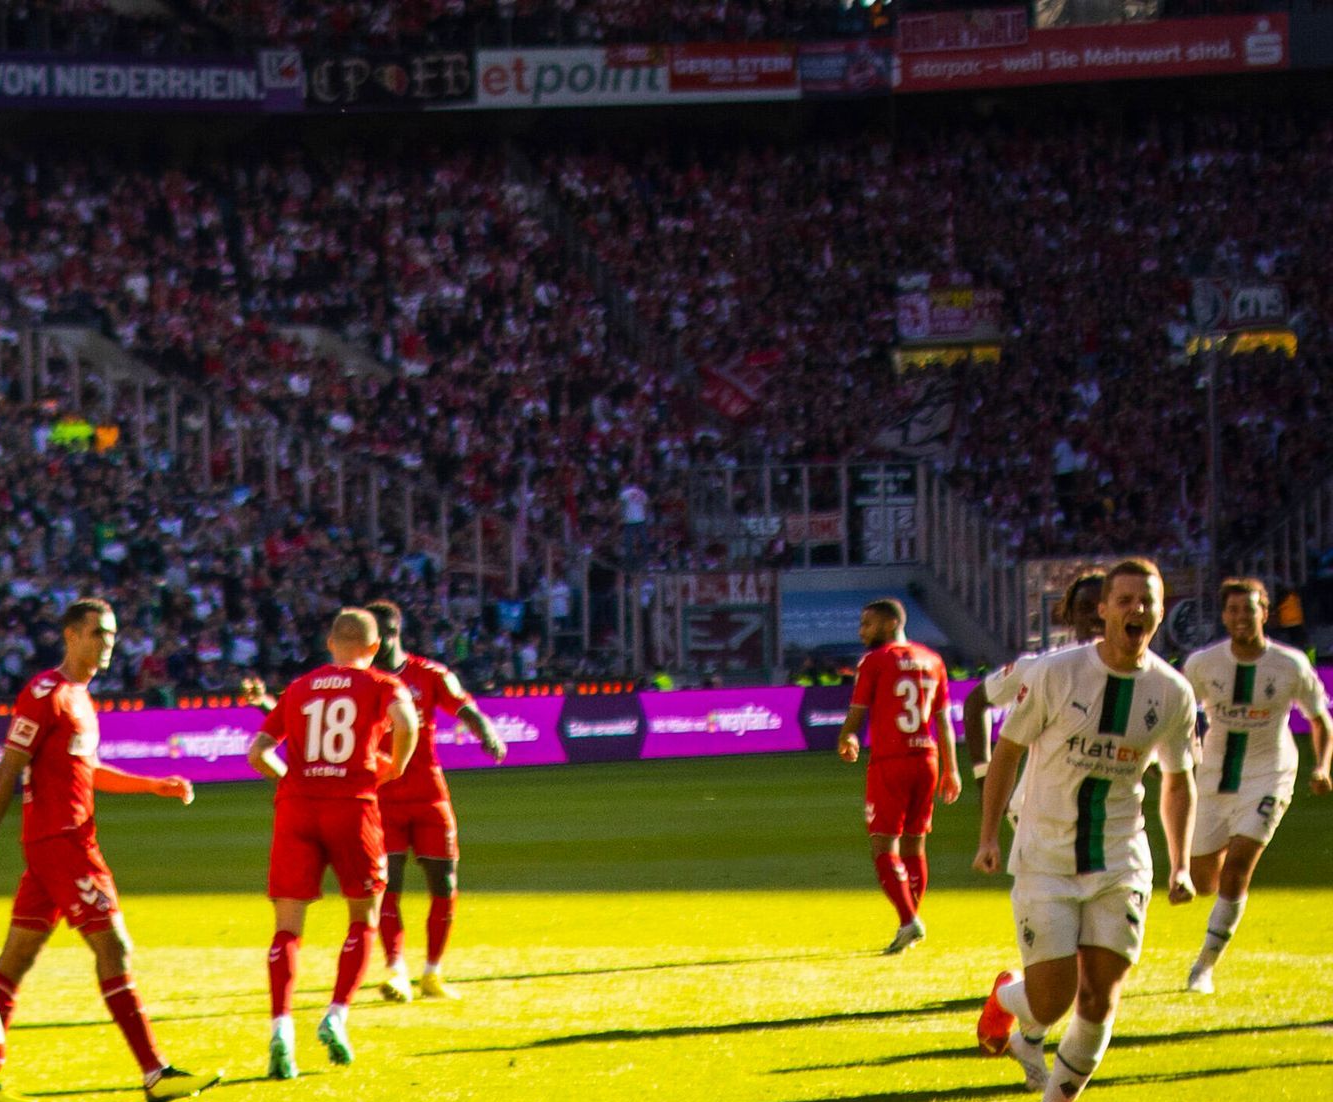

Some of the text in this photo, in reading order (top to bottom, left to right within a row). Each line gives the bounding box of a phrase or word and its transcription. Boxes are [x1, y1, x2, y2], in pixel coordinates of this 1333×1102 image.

[1002, 51, 1044, 72] weil
[1047, 50, 1080, 70] Sie
[1083, 44, 1182, 66] Mehrwert
[52, 64, 268, 102] NIEDERRHEIN.
[311, 675, 352, 690] DUDA
[895, 677, 939, 734] 37
[301, 696, 358, 765] 18
